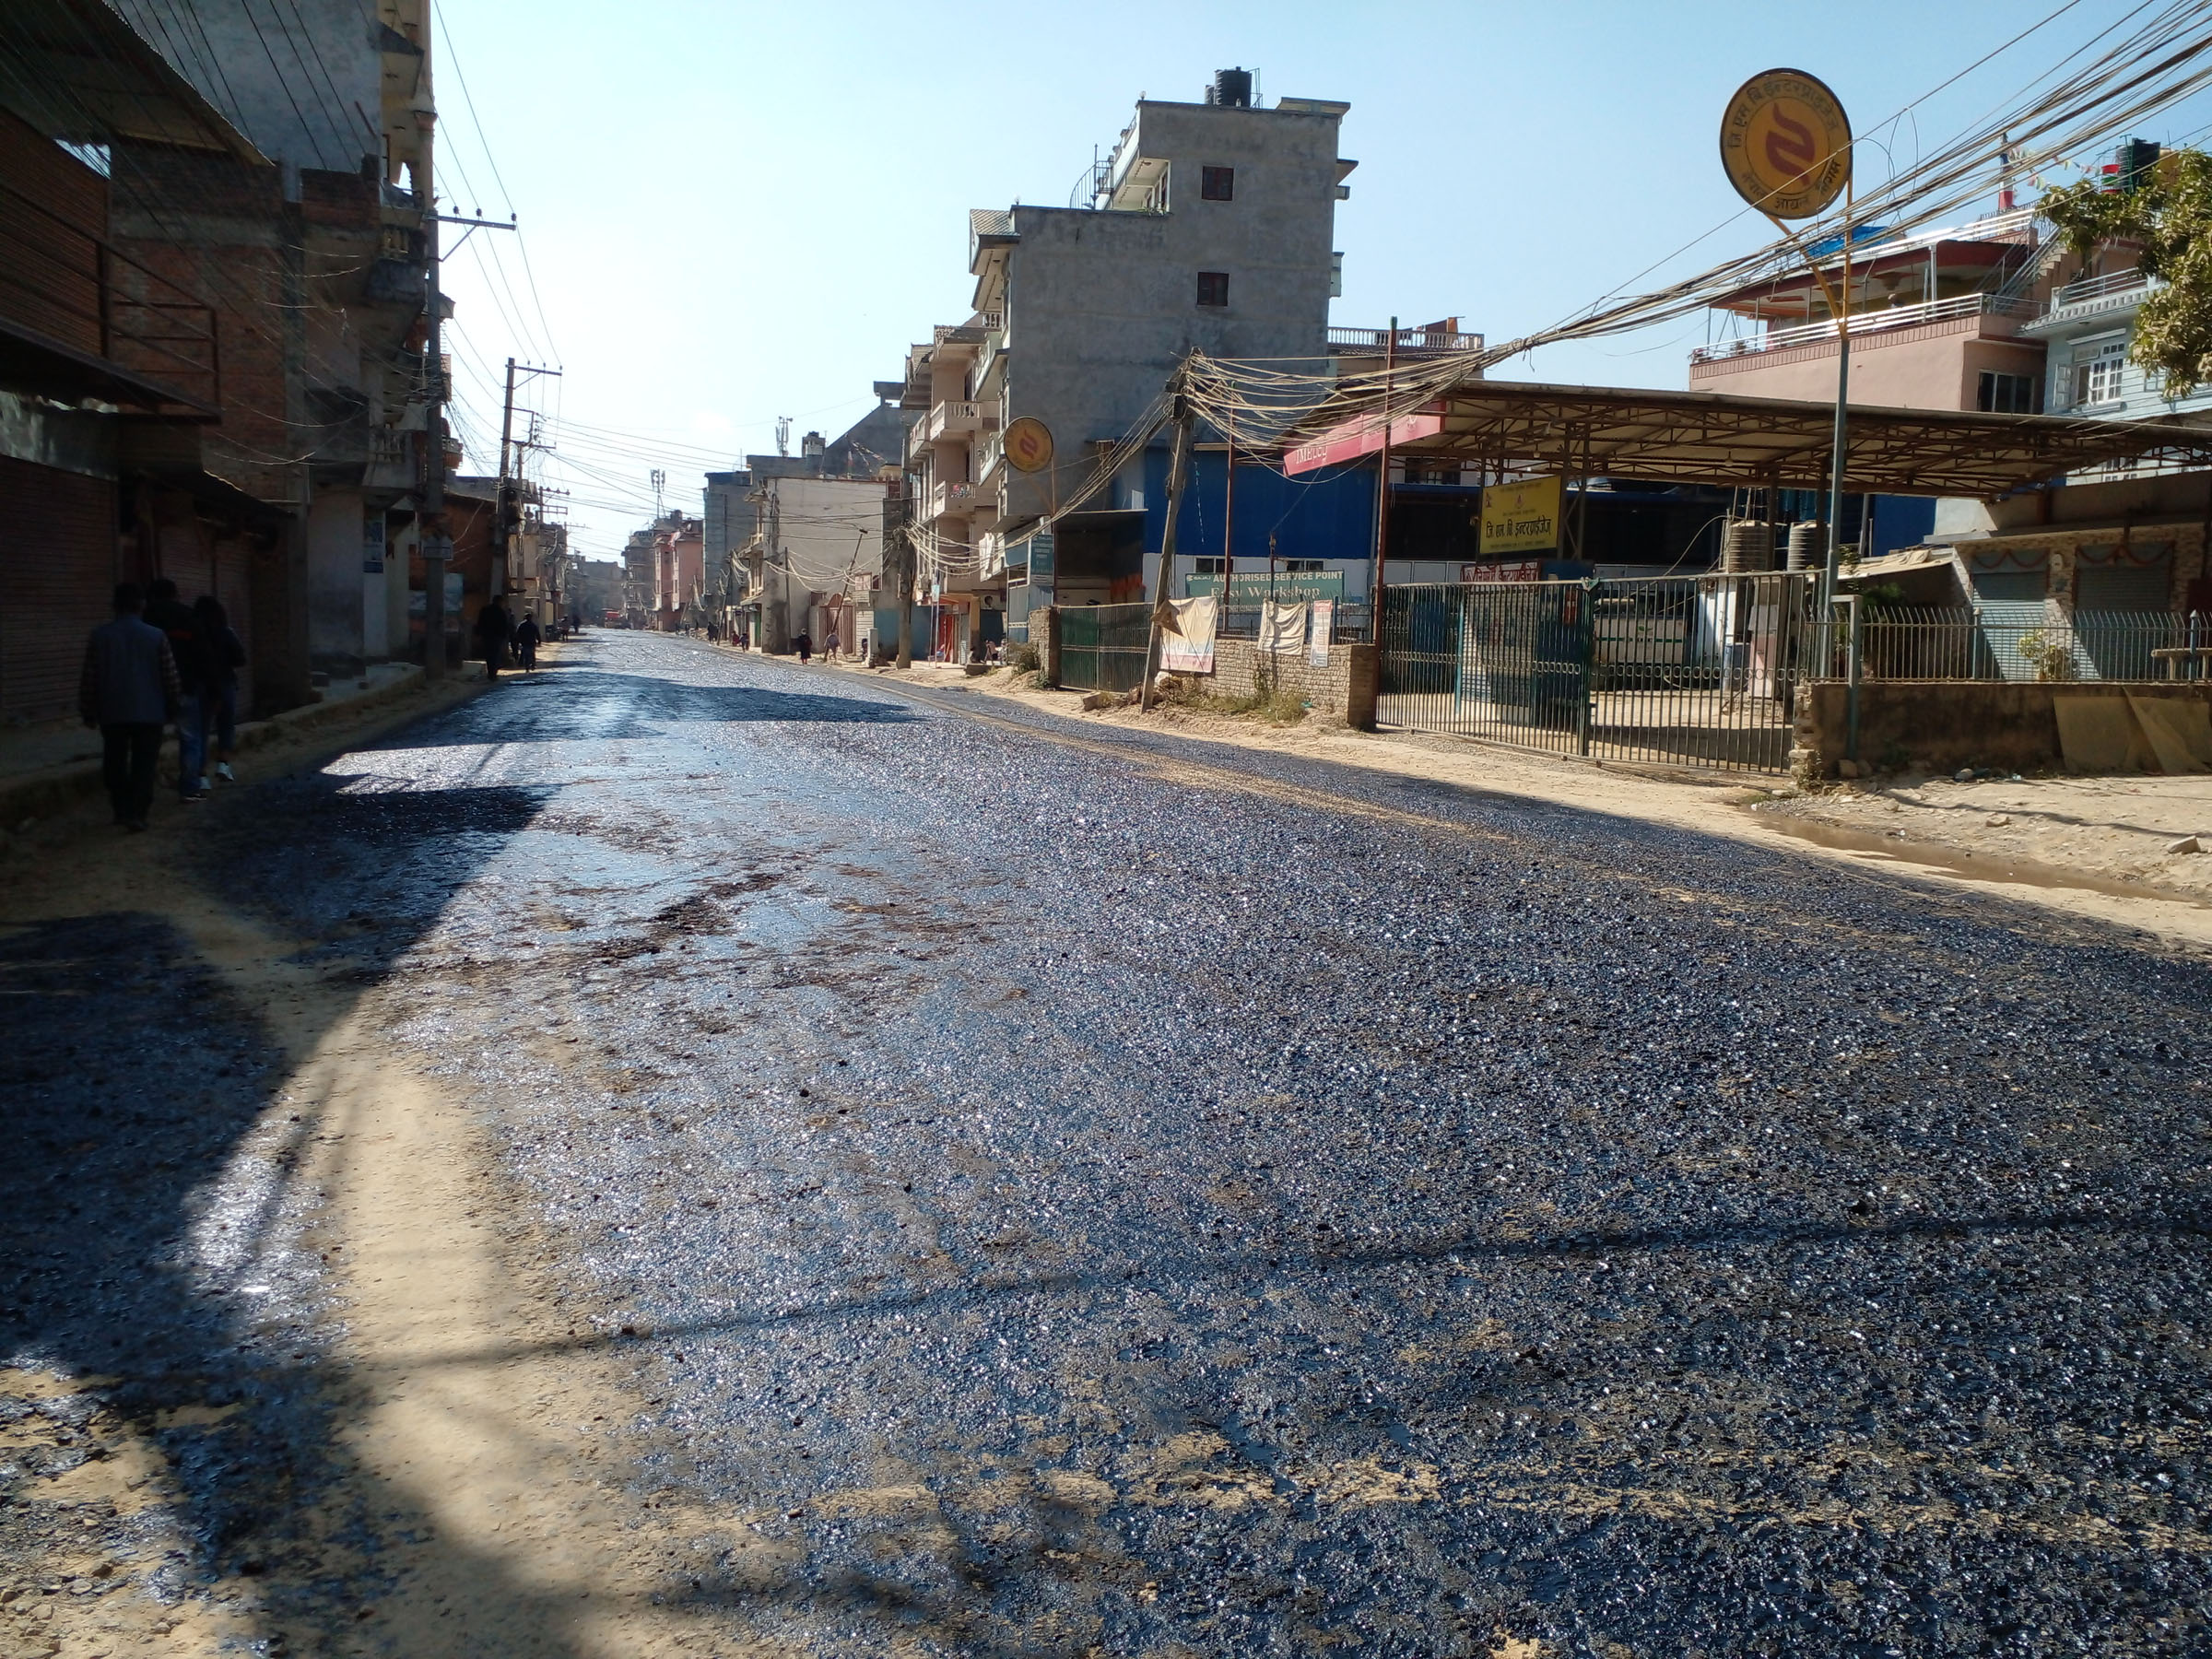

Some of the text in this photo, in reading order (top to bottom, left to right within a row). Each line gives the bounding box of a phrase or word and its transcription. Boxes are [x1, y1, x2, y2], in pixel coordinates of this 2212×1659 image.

[1213, 573, 1272, 582] AUHORISED
[1274, 572, 1313, 582] SERVICE
[1315, 571, 1344, 580] POINT
